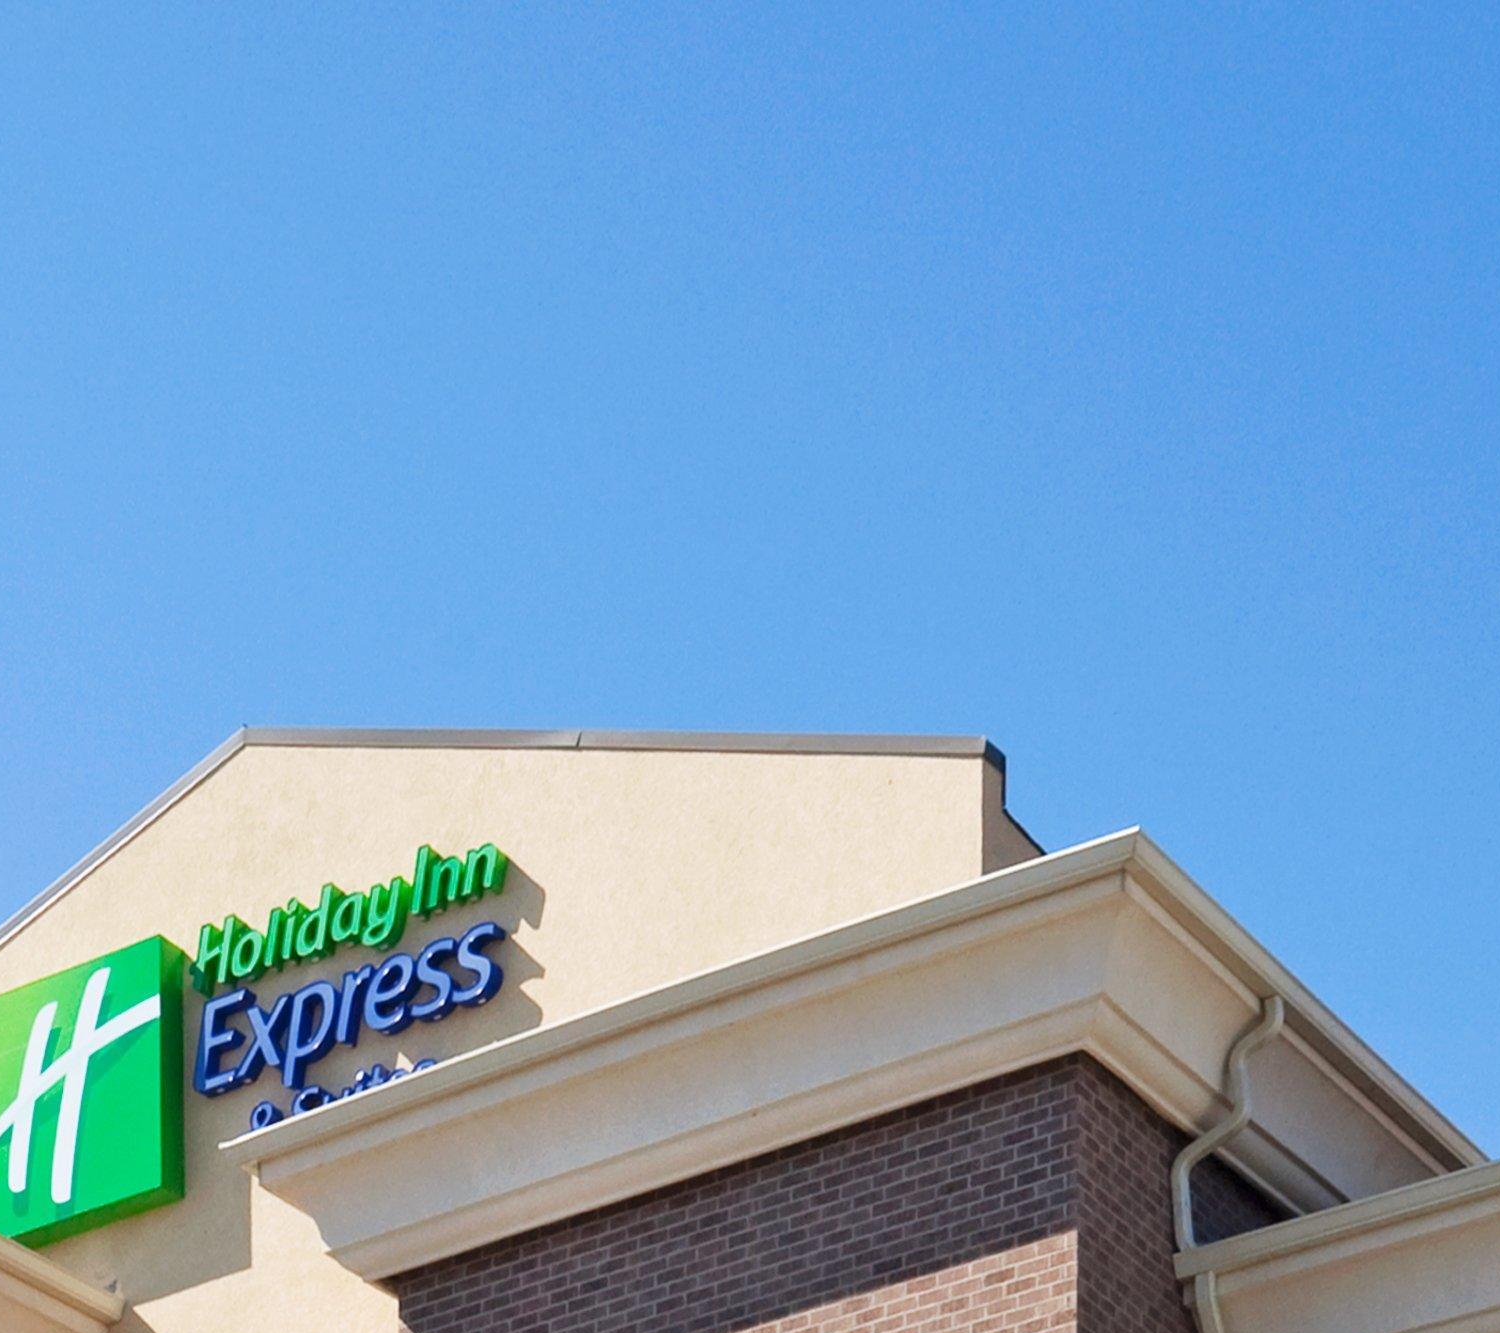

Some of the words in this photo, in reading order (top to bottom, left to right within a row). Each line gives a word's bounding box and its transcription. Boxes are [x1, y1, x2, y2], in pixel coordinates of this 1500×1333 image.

[194, 874, 405, 988] Holiday
[409, 844, 504, 919] Inn
[197, 921, 503, 1094] Express
